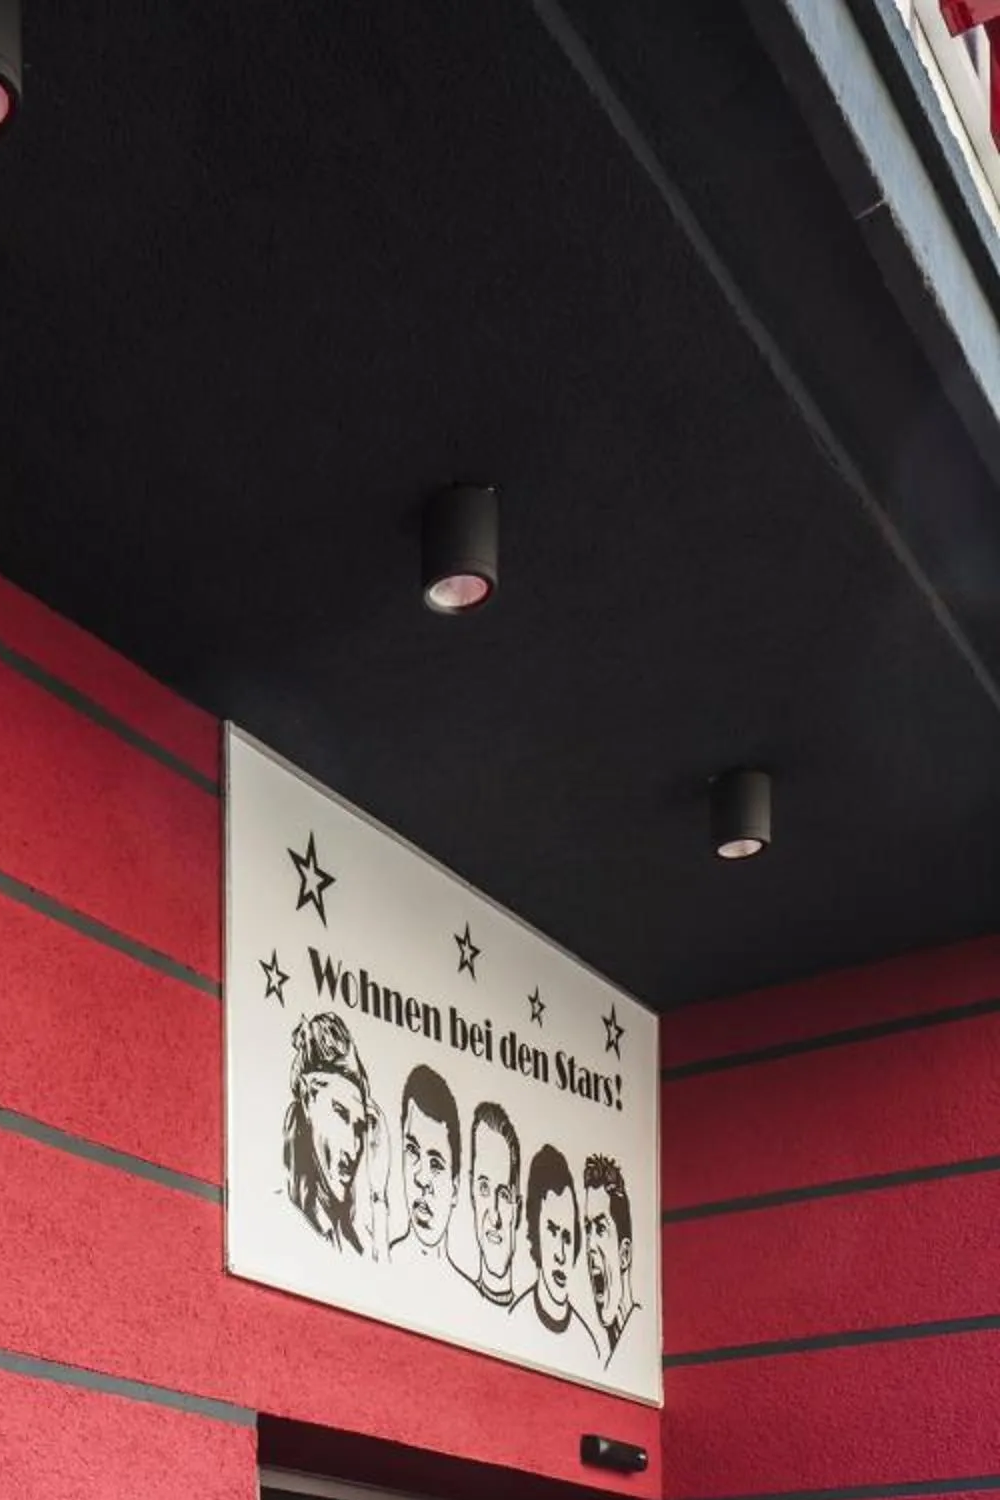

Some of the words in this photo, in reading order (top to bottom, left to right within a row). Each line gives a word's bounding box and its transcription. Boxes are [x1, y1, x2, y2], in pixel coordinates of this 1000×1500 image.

[308, 946, 442, 1042] Wohnen
[449, 1006, 493, 1062] bei
[500, 1031, 549, 1084] den
[555, 1050, 623, 1111] Stars!
